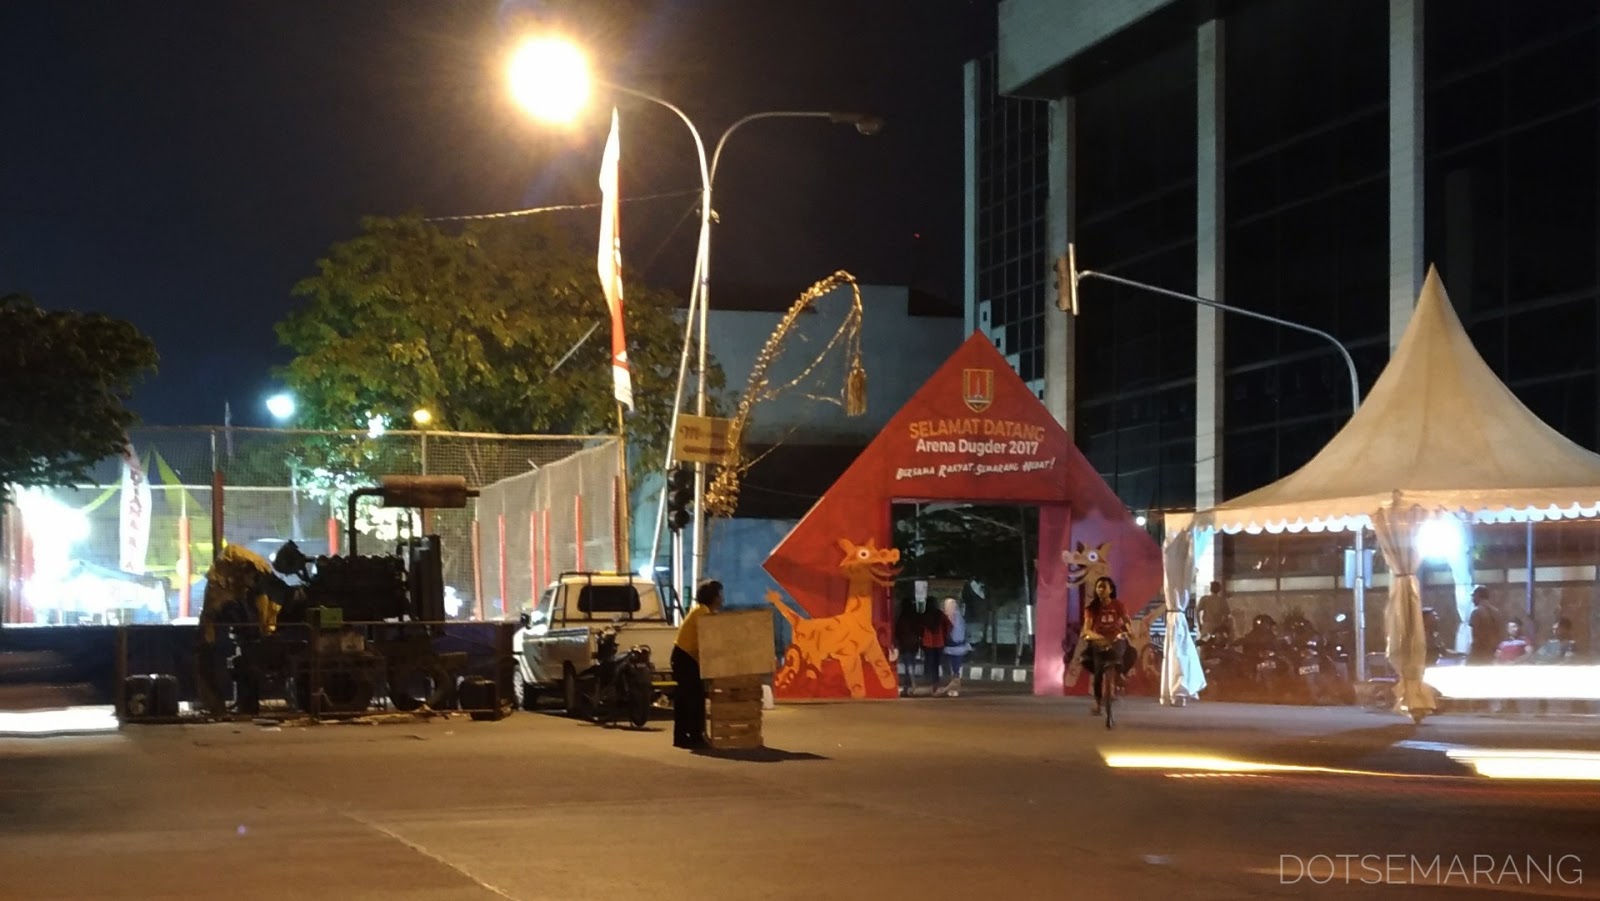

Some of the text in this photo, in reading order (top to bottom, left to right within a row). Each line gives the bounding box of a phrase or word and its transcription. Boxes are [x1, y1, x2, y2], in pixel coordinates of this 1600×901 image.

[909, 418, 1046, 442] SELAMAT DATANG
[916, 438, 1039, 456] Arena Dugder 2017
